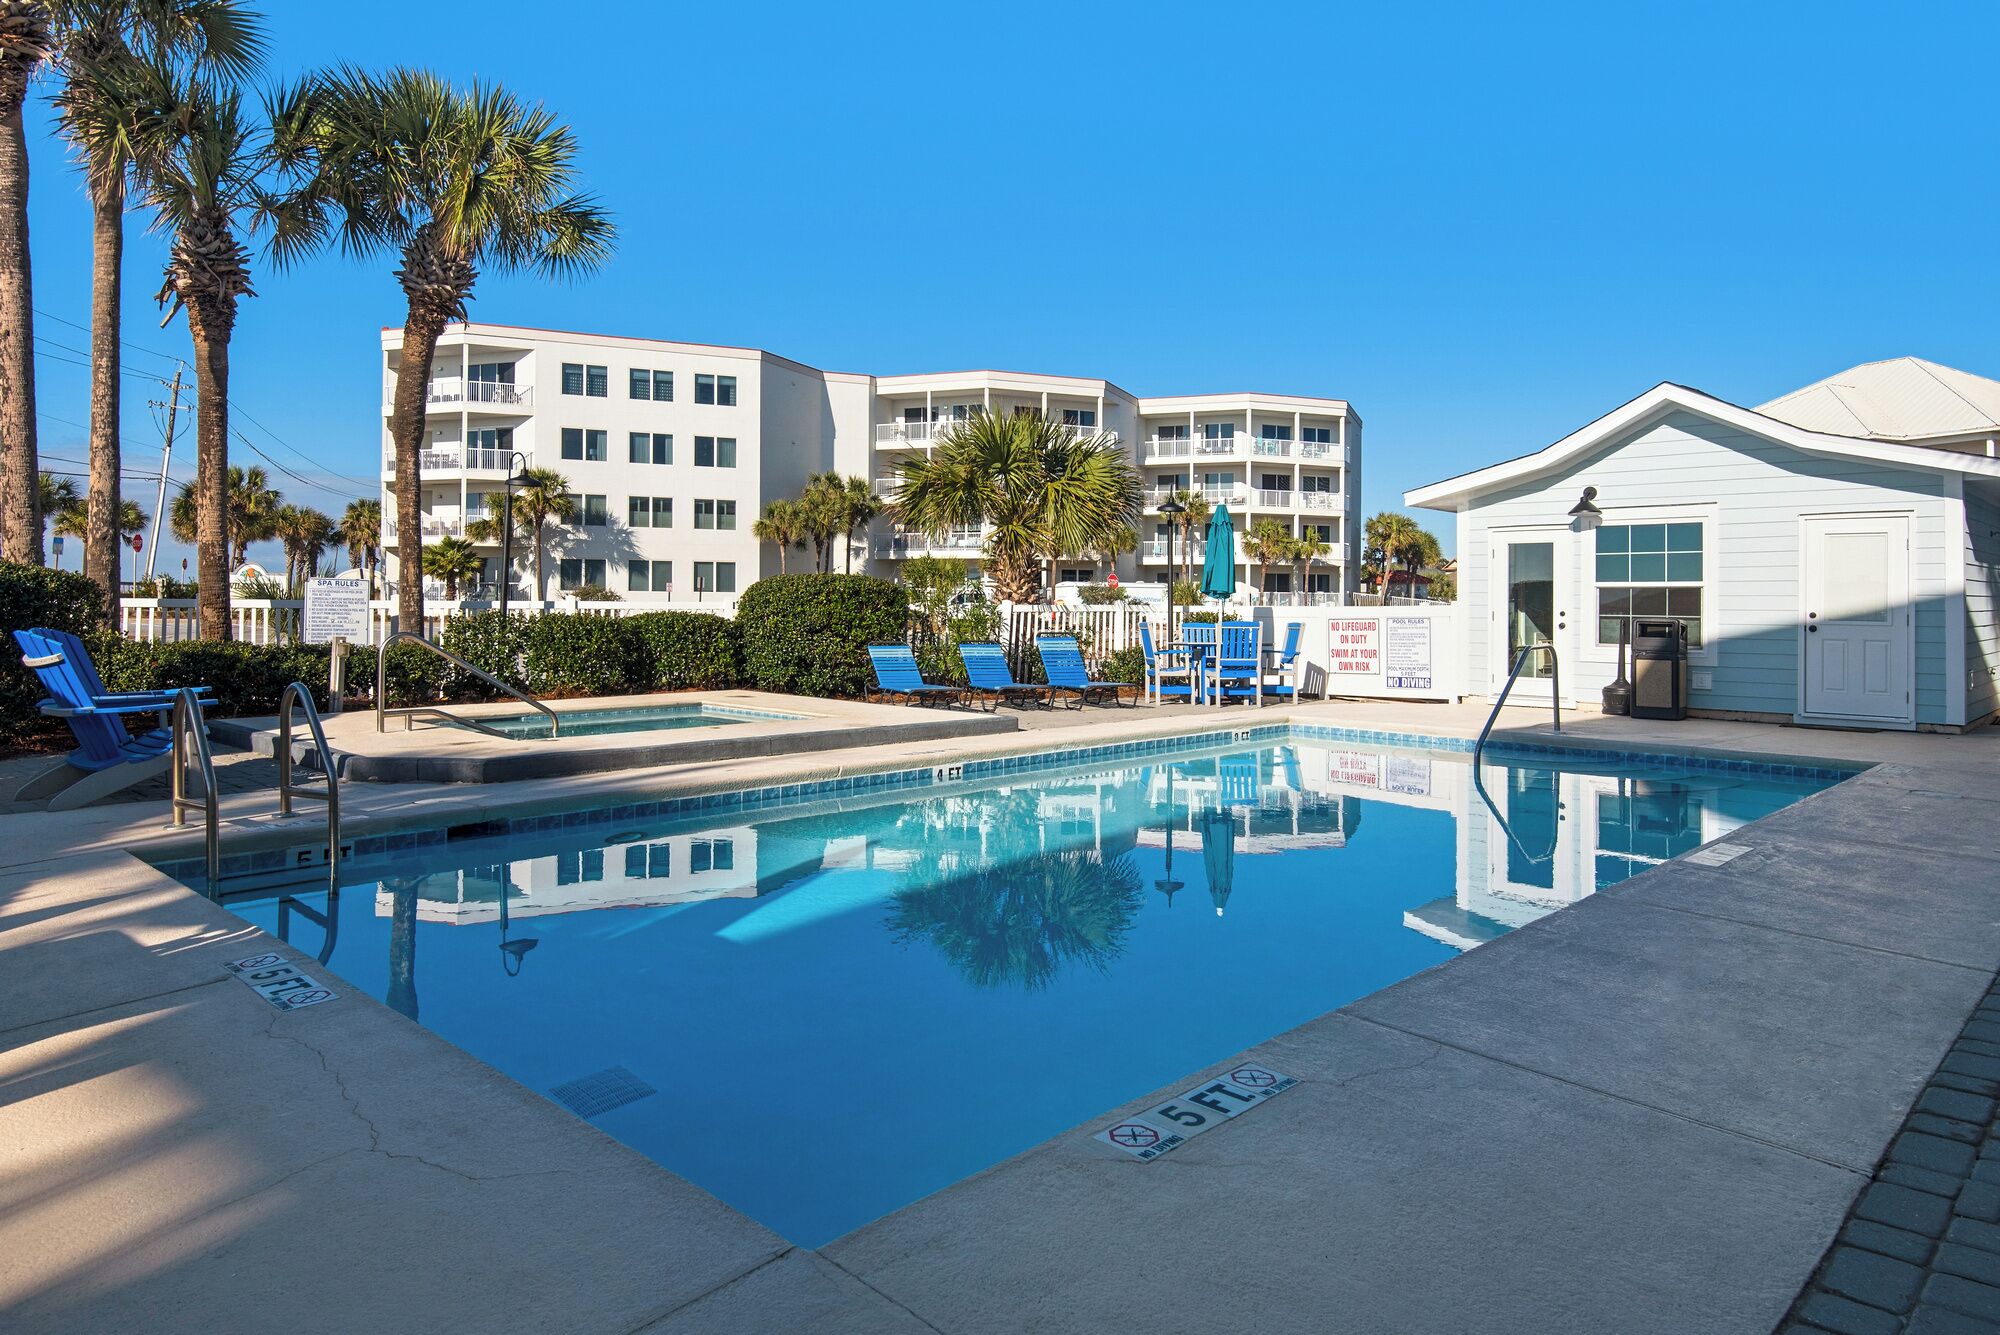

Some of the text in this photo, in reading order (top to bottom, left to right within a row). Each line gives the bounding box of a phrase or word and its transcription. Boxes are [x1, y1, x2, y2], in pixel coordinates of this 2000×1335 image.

[1331, 622, 1376, 632] NO LIFEGUARD
[1340, 634, 1368, 645] ON DUTY
[1331, 648, 1378, 659] SWIM AT YOUR
[1338, 661, 1370, 671] OWN RISK
[1388, 677, 1431, 688] NO DIVING
[251, 968, 293, 979] 5
[1158, 1105, 1206, 1127] 5
[1137, 1135, 1184, 1160] NO DIVING
